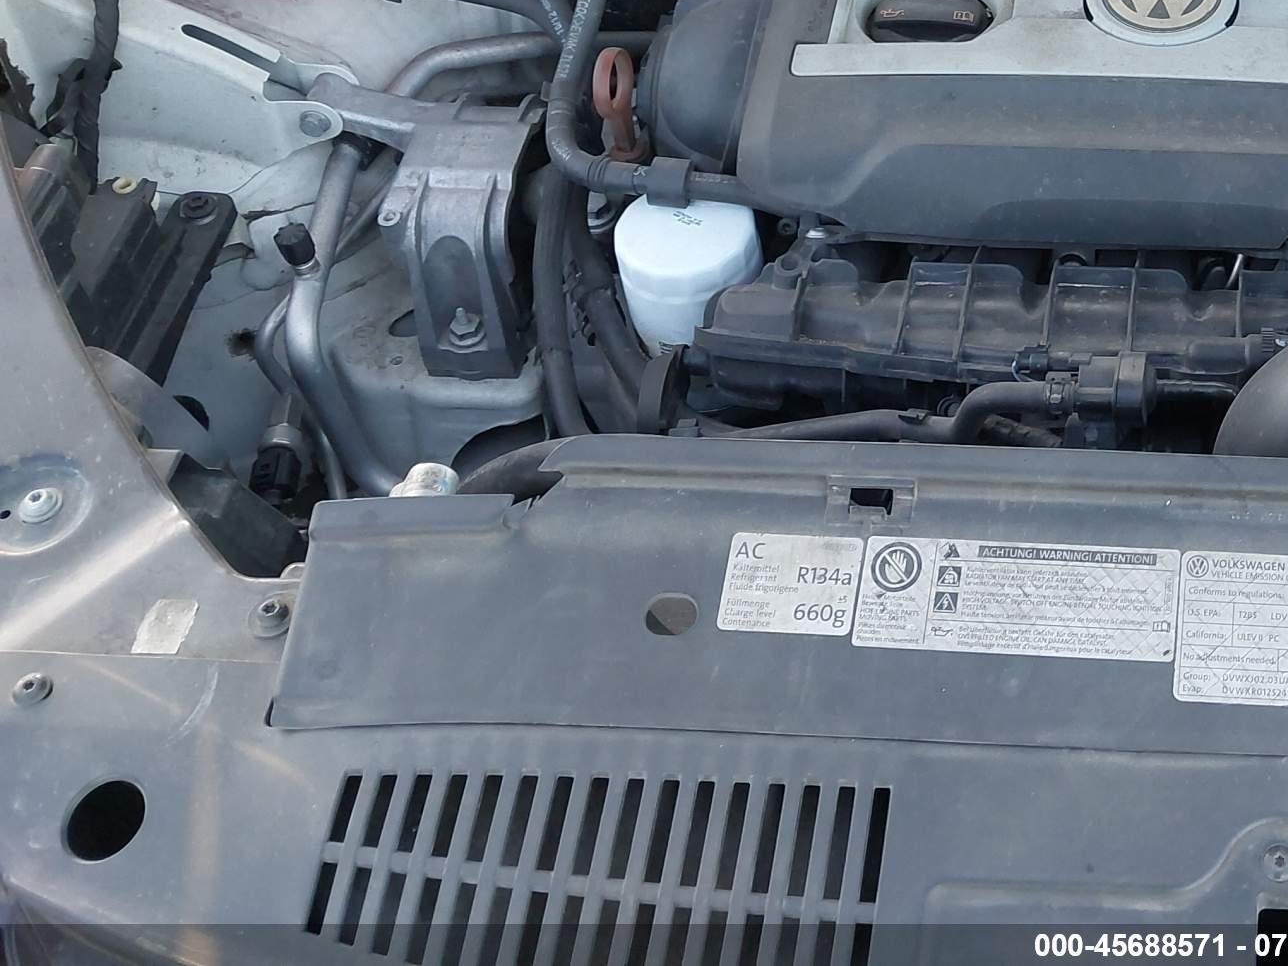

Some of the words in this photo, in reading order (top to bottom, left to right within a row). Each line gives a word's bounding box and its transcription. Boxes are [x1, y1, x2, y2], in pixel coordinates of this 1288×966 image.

[735, 542, 766, 559] AC
[982, 547, 1037, 559] ACHTUNG!
[1040, 549, 1092, 562] WARNING!
[1095, 552, 1154, 564] ATTENTION!
[1212, 559, 1286, 572] VOLKSWAGEN
[797, 566, 852, 586] R134a
[1211, 571, 1243, 579] VEHICLE
[1245, 572, 1284, 581] EMISSION
[1188, 586, 1226, 596] Conforms
[1228, 588, 1236, 596] to
[757, 610, 776, 618] level
[793, 604, 847, 628] 660g
[1270, 612, 1288, 620] LDV
[722, 618, 771, 627] Contenance
[1268, 634, 1280, 642] PC
[1196, 653, 1245, 664] adjustments
